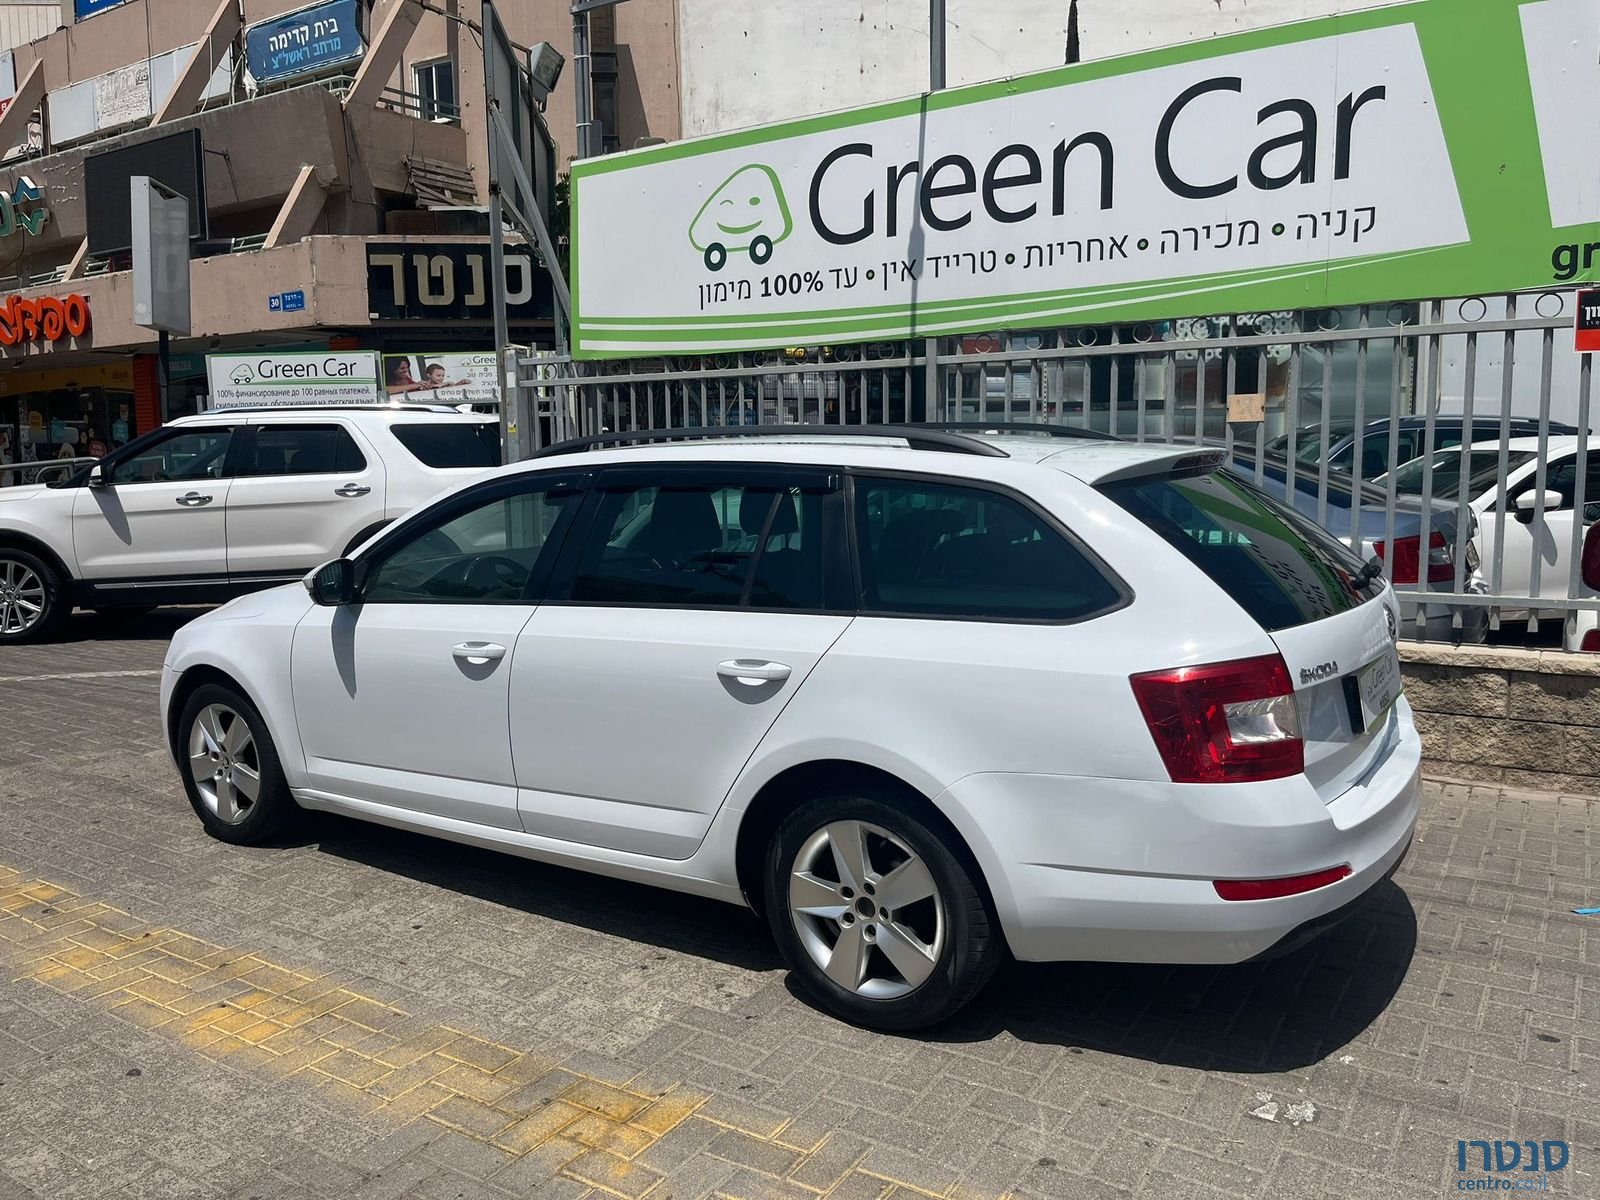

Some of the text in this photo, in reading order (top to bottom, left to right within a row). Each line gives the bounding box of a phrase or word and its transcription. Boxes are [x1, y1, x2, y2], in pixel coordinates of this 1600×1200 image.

[269, 18, 339, 52] בית קדימה
[312, 37, 341, 56] מרחב
[808, 76, 1387, 246] Green Car
[698, 206, 1376, 311] קניה מכירה אחריות טרייד אין עד 100% מימון
[369, 254, 533, 306] סנטר
[270, 298, 280, 308] 30
[258, 358, 357, 379] Green Car
[473, 356, 496, 364] Gree
[217, 389, 235, 398] 100%
[235, 389, 291, 399] финансирование
[291, 389, 300, 397] до
[301, 387, 314, 396] 100
[314, 388, 338, 397] равных
